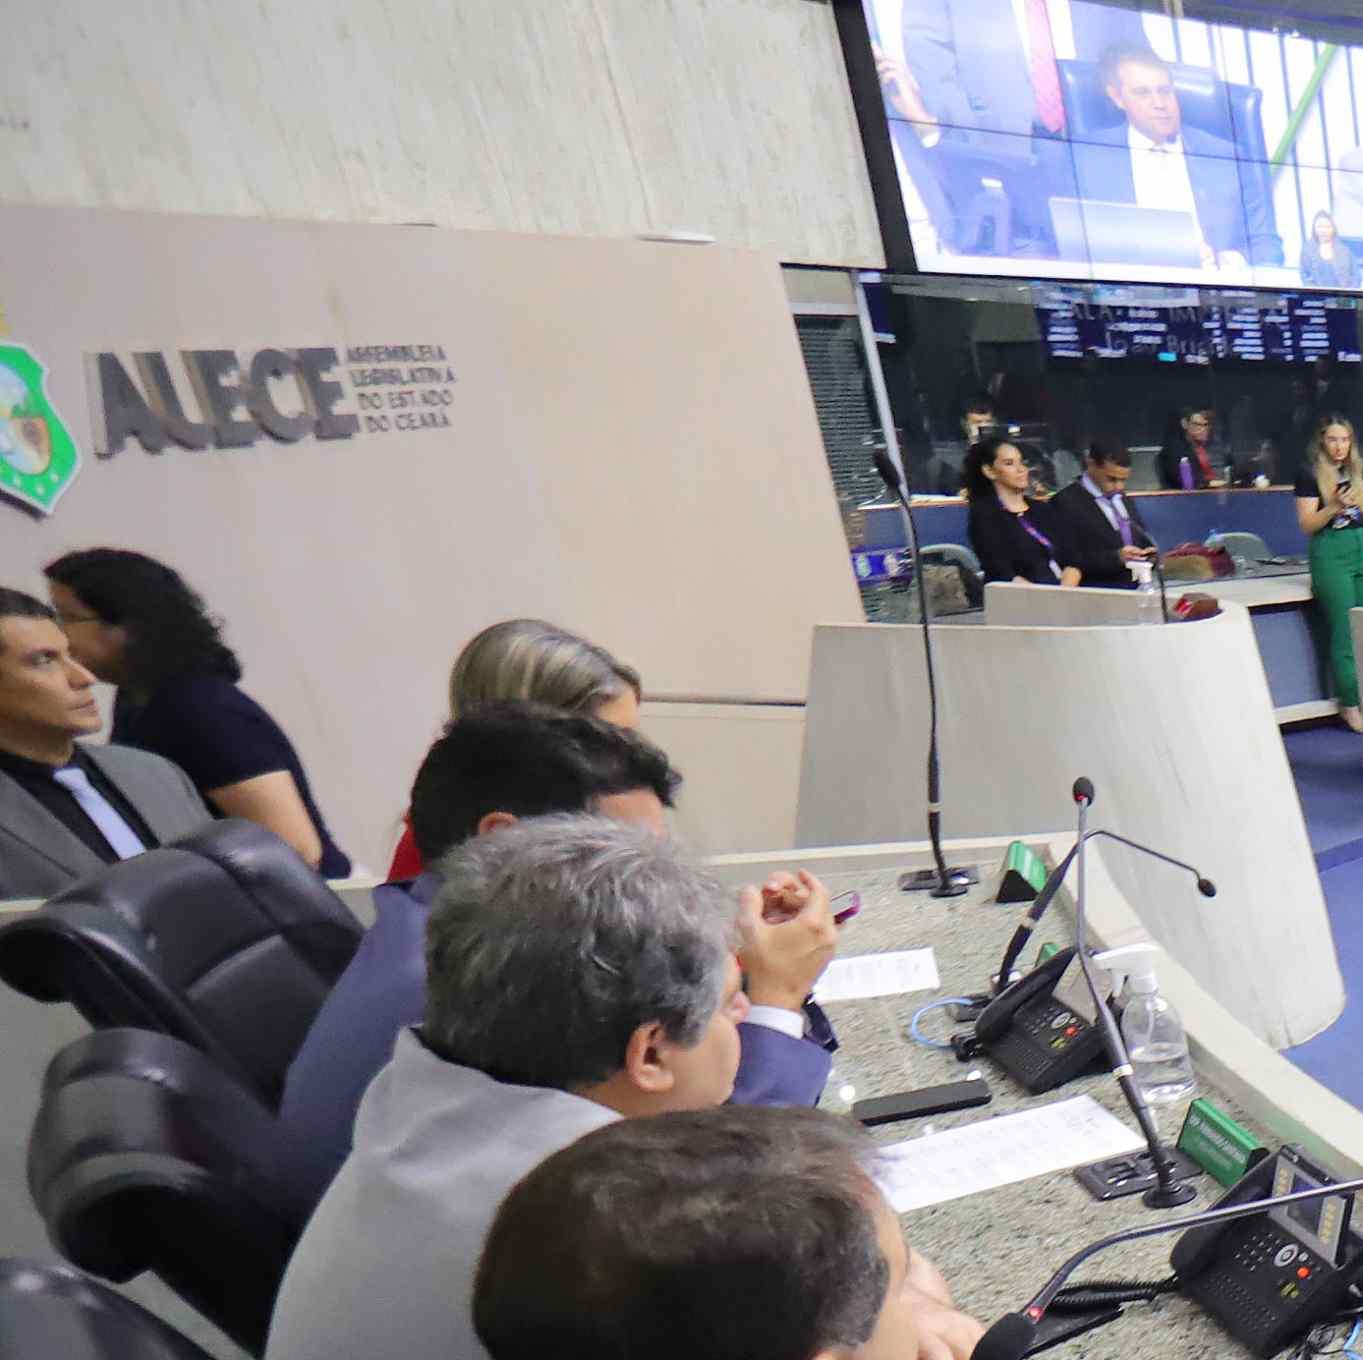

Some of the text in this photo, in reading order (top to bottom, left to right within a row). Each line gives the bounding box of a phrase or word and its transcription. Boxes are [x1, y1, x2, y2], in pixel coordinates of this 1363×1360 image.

[87, 347, 360, 459] ALECE
[357, 389, 454, 410] DO ESTADO
[366, 414, 389, 433] DO
